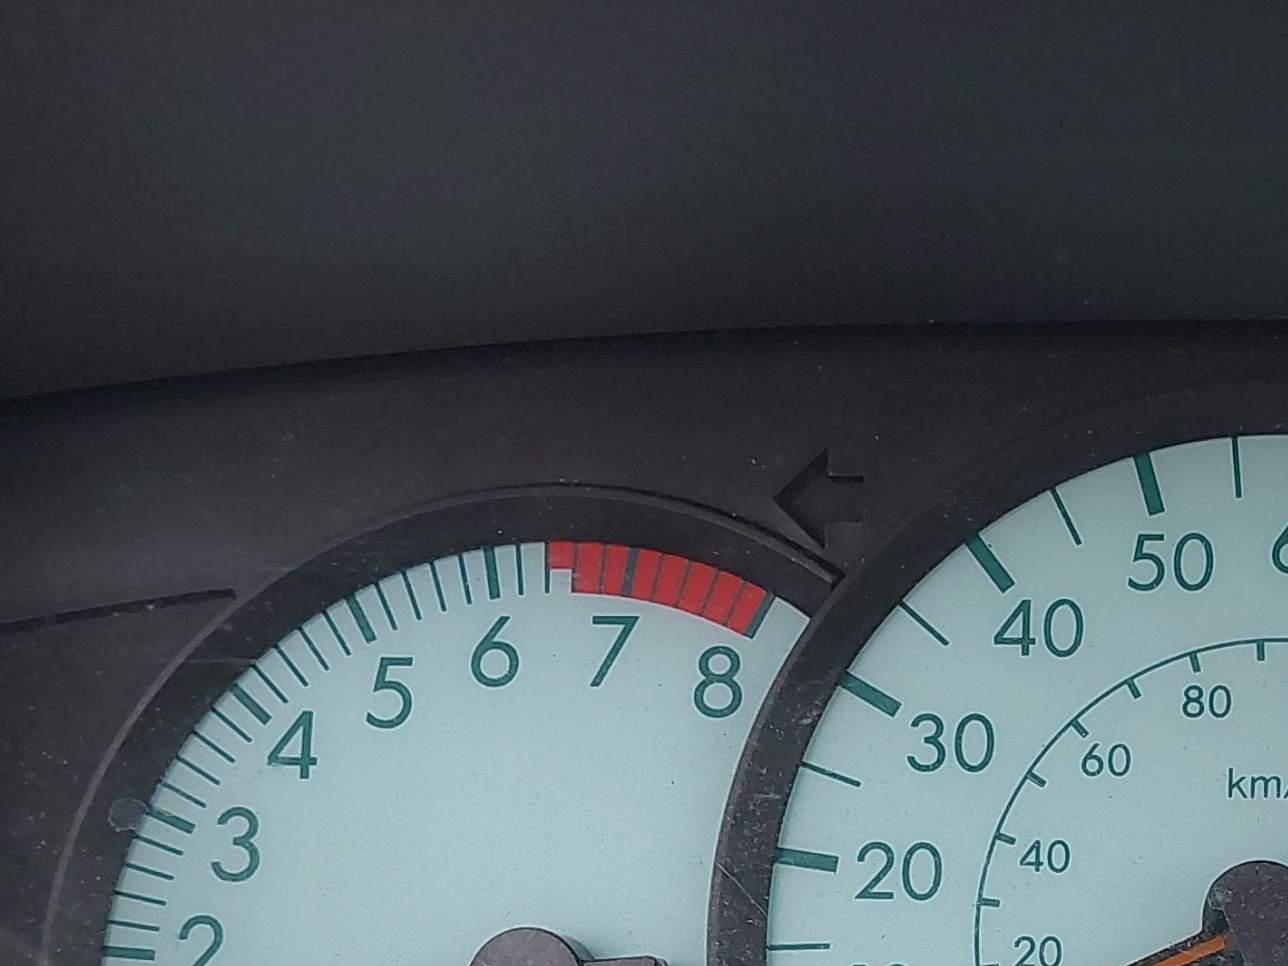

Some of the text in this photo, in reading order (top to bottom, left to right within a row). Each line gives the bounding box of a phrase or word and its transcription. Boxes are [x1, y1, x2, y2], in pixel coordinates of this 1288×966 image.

[1128, 533, 1213, 591] 50
[471, 616, 519, 687] 6
[590, 616, 640, 687] 7
[994, 599, 1083, 657] 40
[366, 657, 413, 729] 5
[694, 646, 742, 718] 8
[1182, 685, 1231, 718] 80
[266, 710, 317, 779] 4
[907, 713, 994, 772] 30
[1082, 743, 1131, 776] 60
[211, 807, 260, 882] 3
[855, 842, 942, 901] 20
[1020, 840, 1070, 873] 40
